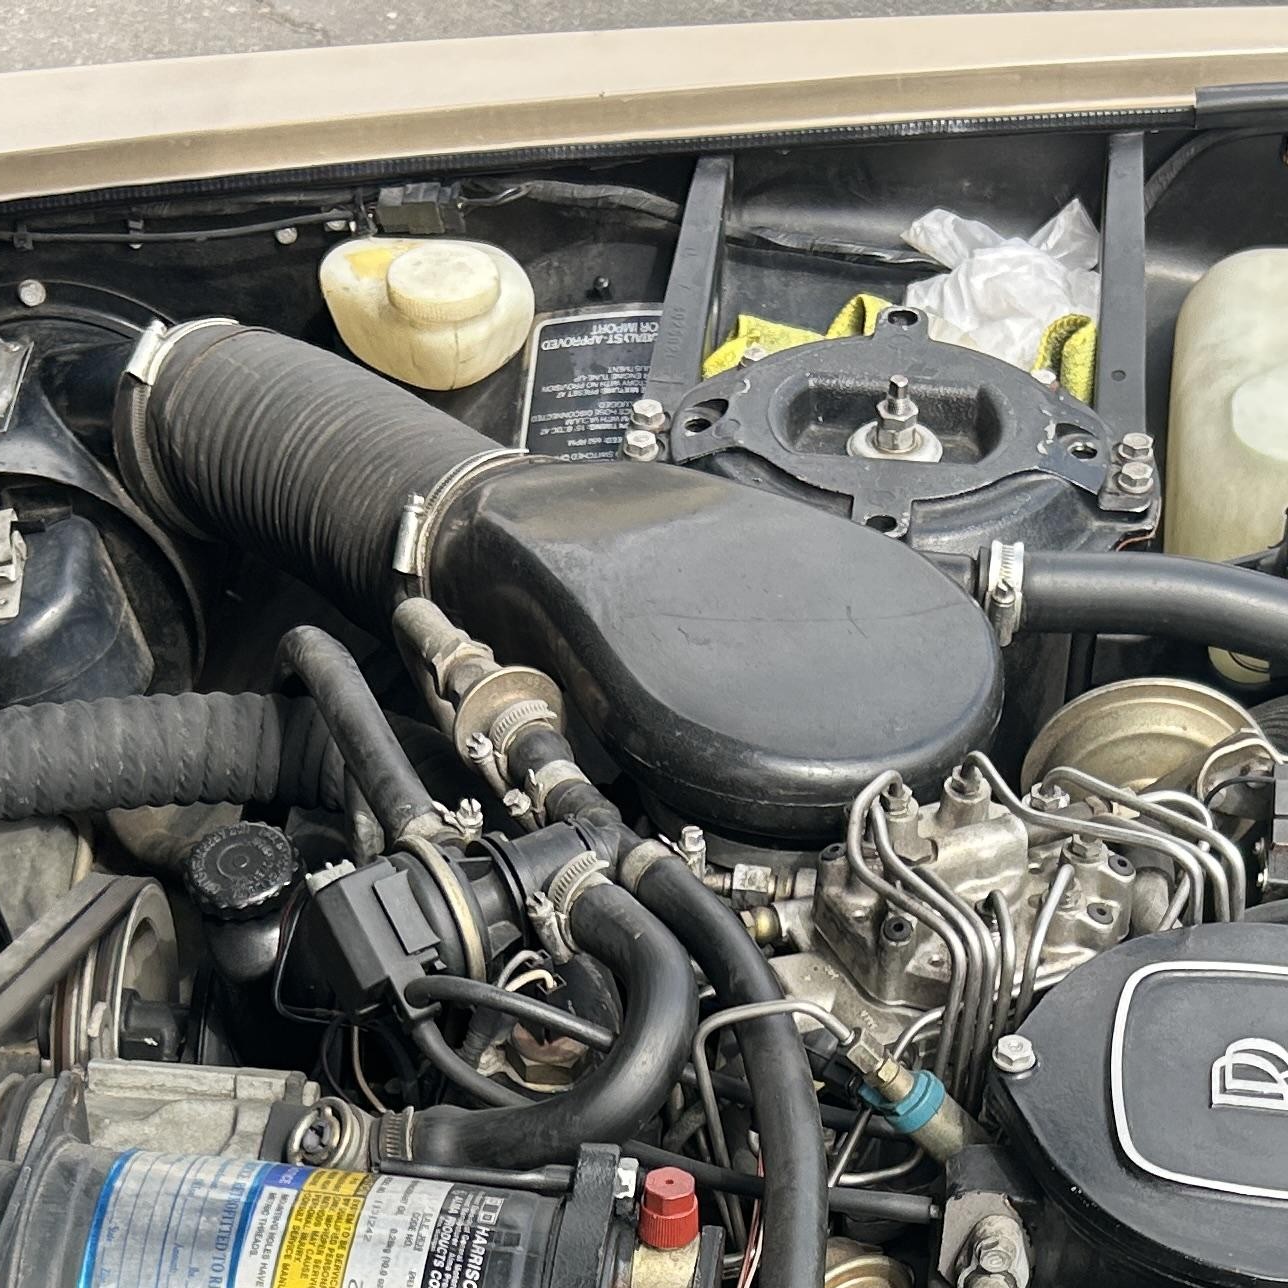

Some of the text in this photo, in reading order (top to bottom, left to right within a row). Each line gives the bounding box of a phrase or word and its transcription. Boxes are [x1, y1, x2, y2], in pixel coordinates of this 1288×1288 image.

[590, 322, 659, 334] OR IMPORT
[214, 1181, 245, 1251] RETROFITTED
[308, 1229, 319, 1246] MAY
[341, 1226, 351, 1238] TO
[433, 1214, 455, 1268] PRODUCTS
[261, 1231, 275, 1260] HOLES
[210, 1253, 226, 1273] TO
[256, 1262, 268, 1288] HAVE
[300, 1247, 314, 1280] CAUSE
